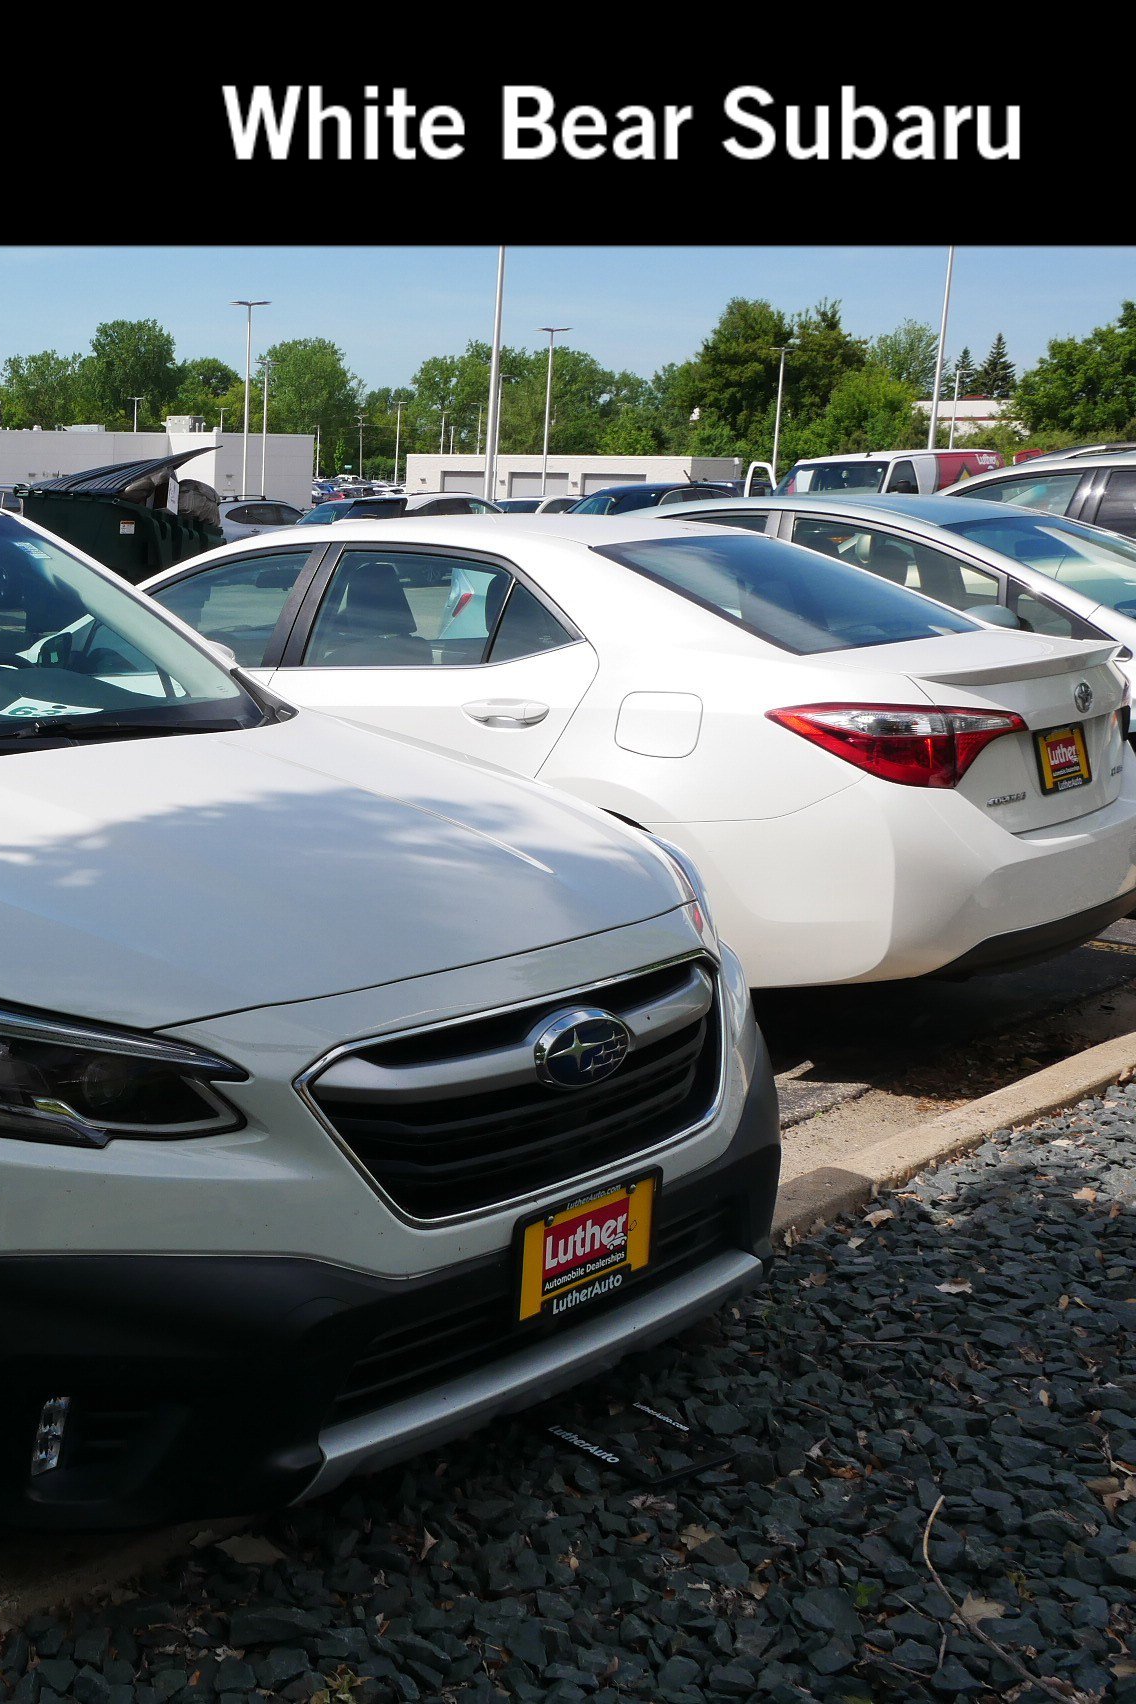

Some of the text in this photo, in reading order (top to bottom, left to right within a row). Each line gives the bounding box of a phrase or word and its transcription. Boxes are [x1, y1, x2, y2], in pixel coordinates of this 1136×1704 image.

[1047, 743, 1077, 766] Luther
[566, 1183, 622, 1211] LutherAuto.com
[544, 1212, 628, 1271] Luther
[544, 1251, 625, 1292] Automobile Dealerships
[552, 1274, 623, 1315] LutherAuto
[632, 1401, 690, 1432] LutherAuto.com
[547, 1424, 620, 1464] LutherAuto
